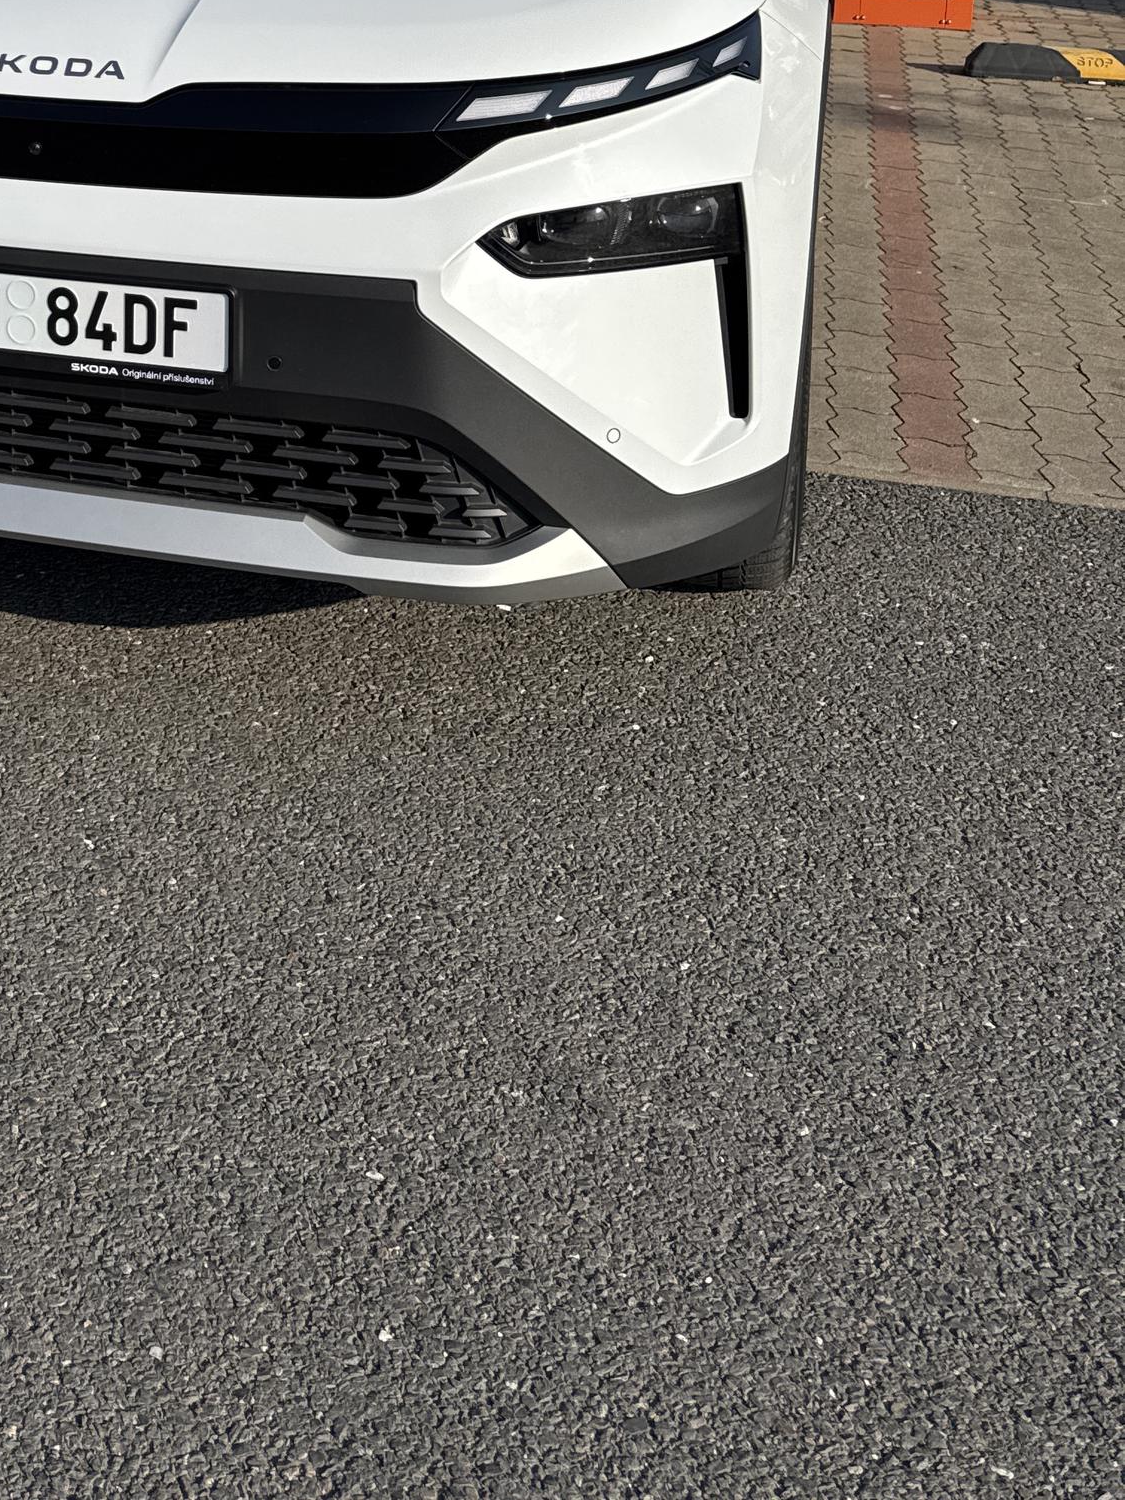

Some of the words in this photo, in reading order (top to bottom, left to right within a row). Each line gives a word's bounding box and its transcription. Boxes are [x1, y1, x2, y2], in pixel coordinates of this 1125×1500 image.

[1076, 56, 1114, 68] STOP
[46, 286, 198, 359] 84DF
[122, 367, 162, 380] Originální
[162, 373, 215, 385] příslušenství
